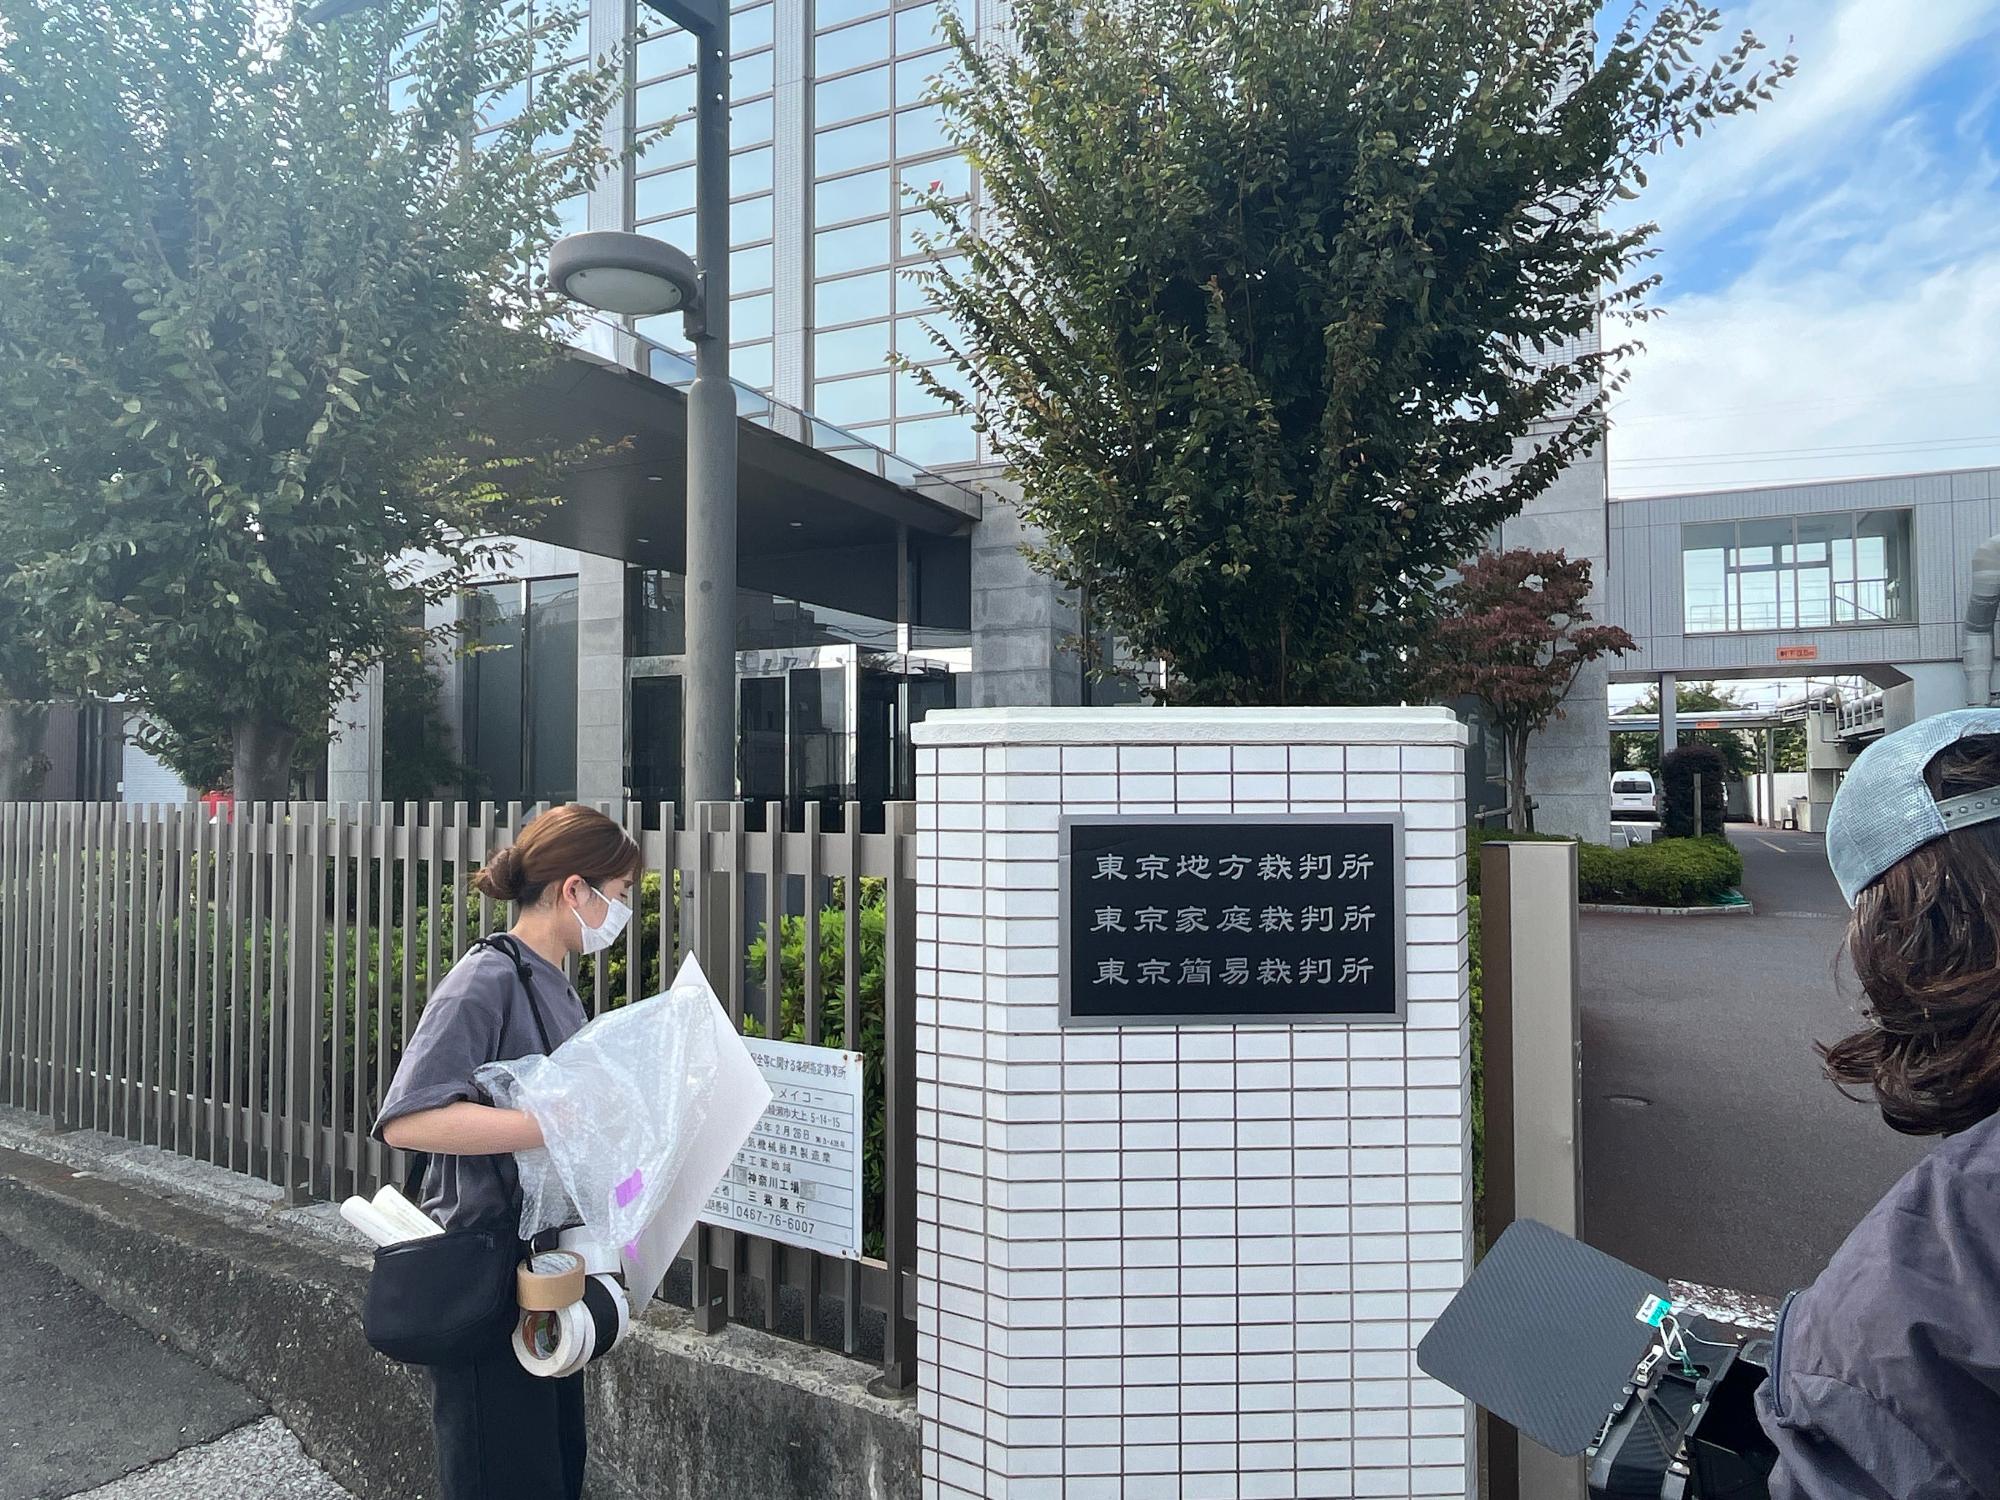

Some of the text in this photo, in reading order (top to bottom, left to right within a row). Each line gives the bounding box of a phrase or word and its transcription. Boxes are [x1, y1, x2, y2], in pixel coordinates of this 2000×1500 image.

[1091, 853, 1376, 881] 東京地方裁判所
[1089, 904, 1377, 933] 東京家庭裁判所
[1091, 956, 1376, 985] 東京簡易裁判所
[779, 1088, 824, 1103] メイコー
[765, 1105, 841, 1128] 綾瀬市大上 5-14-15
[743, 1136, 831, 1163] 気機械器具製造業
[748, 1171, 800, 1194] 神奈川工場
[736, 1205, 815, 1235] 0467-76-6007
